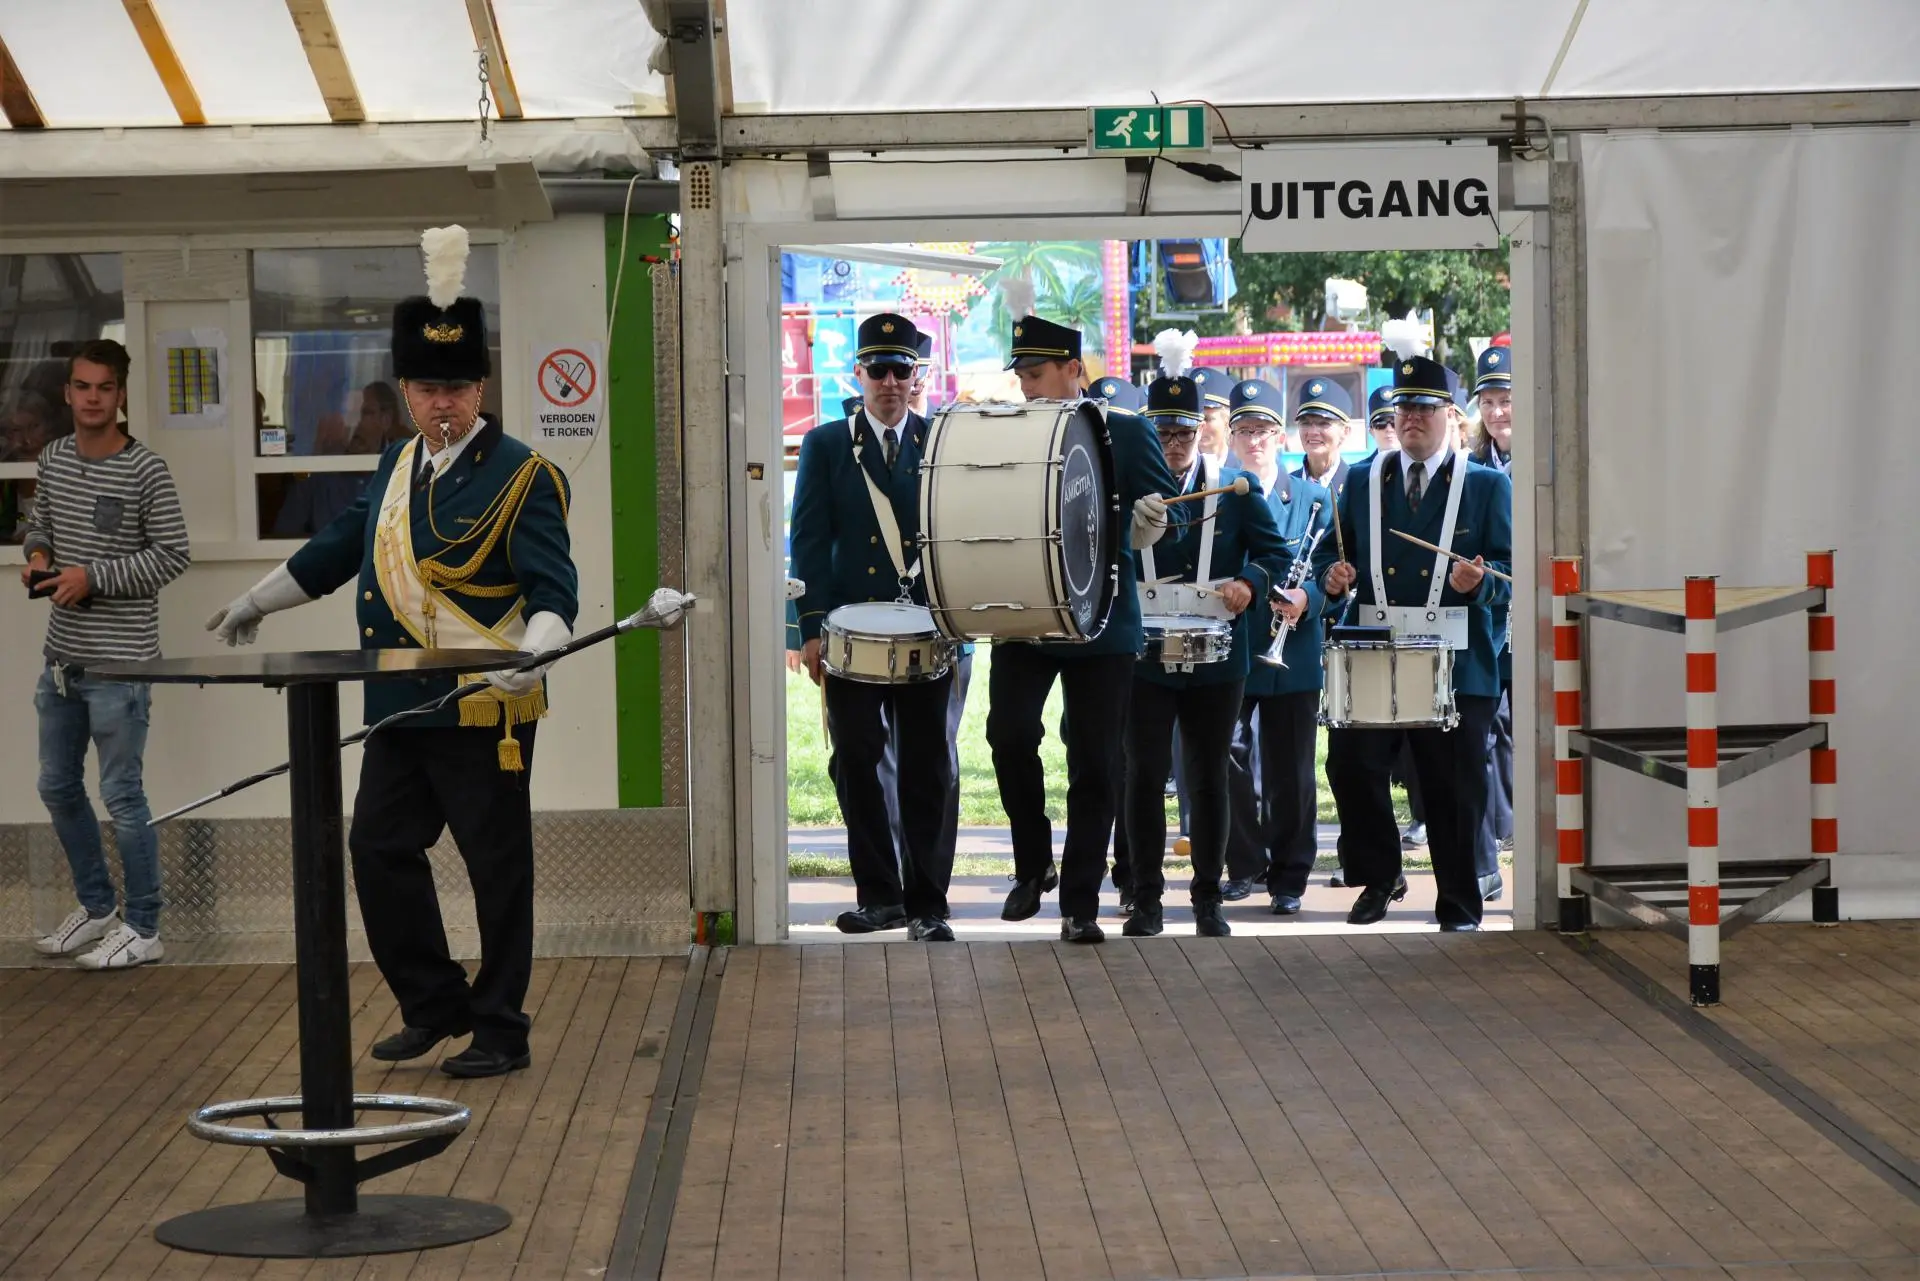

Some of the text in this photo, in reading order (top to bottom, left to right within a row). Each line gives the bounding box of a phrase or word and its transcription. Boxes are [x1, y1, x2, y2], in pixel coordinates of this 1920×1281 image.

[1250, 178, 1489, 221] UITGANG
[540, 413, 595, 423] VERBODEN
[542, 427, 593, 437] TE ROKEN
[1064, 473, 1091, 504] AMICITIA
